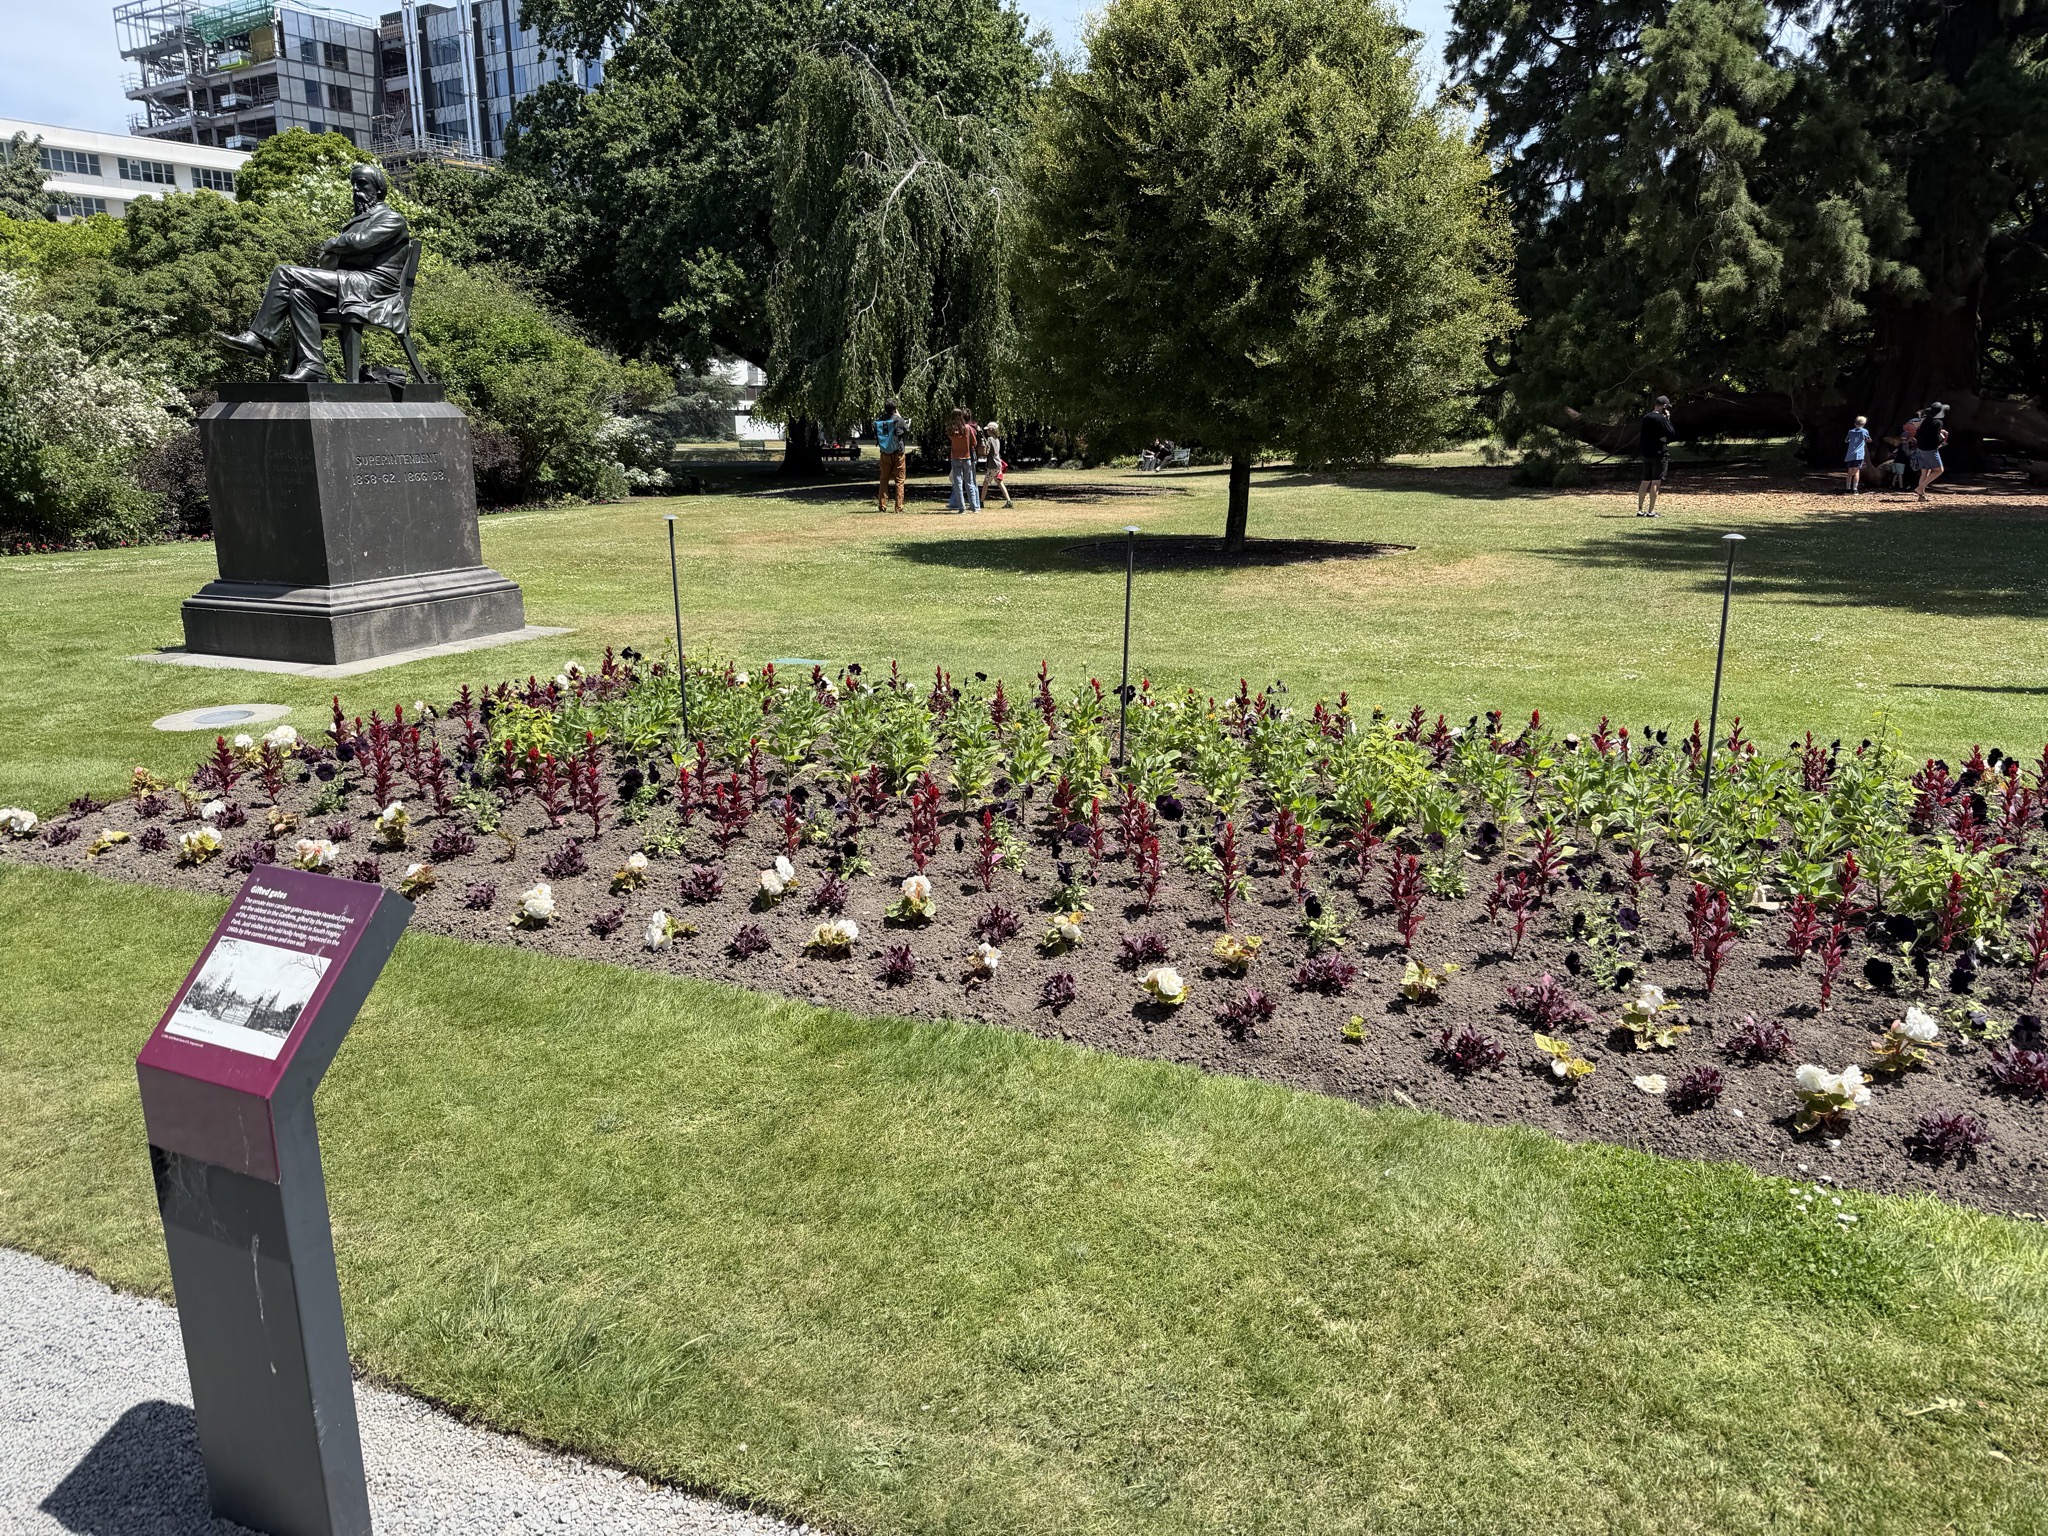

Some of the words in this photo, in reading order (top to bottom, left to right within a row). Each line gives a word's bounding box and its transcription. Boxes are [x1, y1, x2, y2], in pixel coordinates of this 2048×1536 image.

[355, 452, 438, 466] SUPERINTENDENT
[250, 885, 271, 895] Gifted
[268, 890, 287, 899] gates
[274, 904, 291, 912] carriage
[302, 909, 321, 917] opposite
[320, 912, 341, 921] Hereford
[257, 916, 277, 924] Industrial
[276, 919, 298, 928] Exhibition
[312, 926, 325, 934] South
[325, 930, 341, 939] Hagley
[282, 929, 293, 937] holly
[308, 935, 328, 943] replaced
